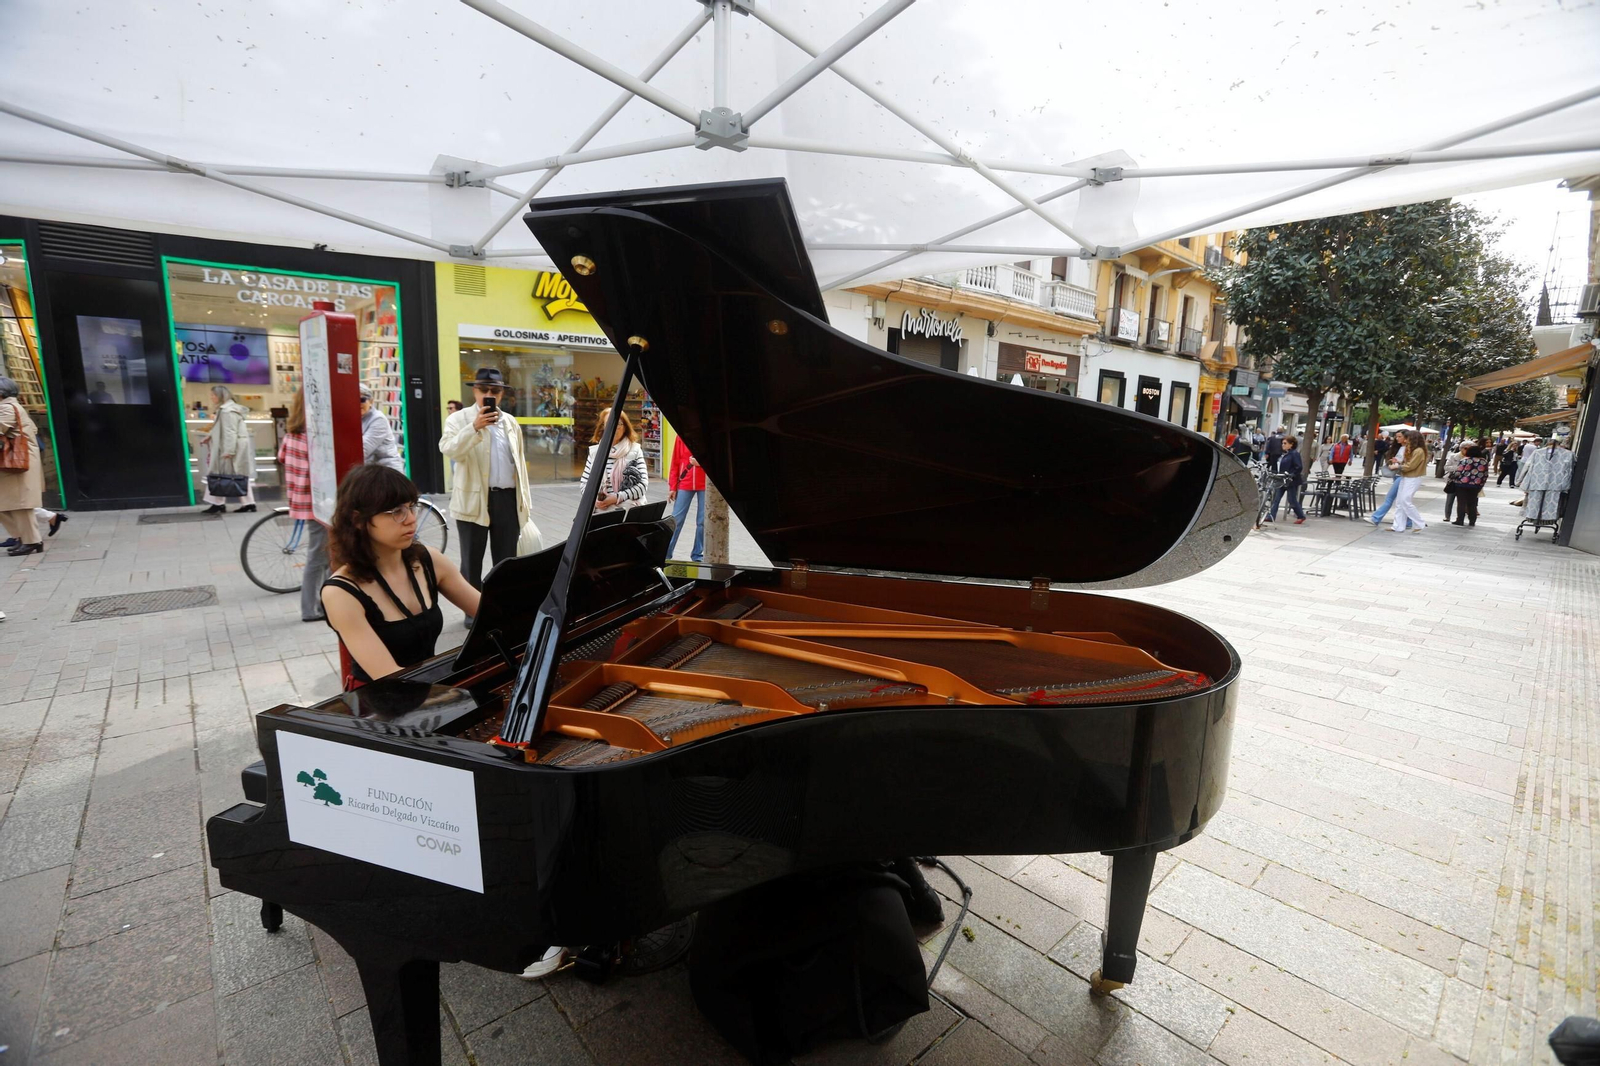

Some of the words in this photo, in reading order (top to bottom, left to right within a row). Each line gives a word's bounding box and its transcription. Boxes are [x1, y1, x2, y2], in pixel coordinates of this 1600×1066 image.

[201, 268, 236, 286] LA
[243, 273, 300, 292] CASA
[302, 279, 330, 295] DE
[335, 282, 372, 299] LAS
[237, 290, 346, 312] CARCASS
[494, 329, 550, 341] GOLOSINAS
[557, 334, 608, 345] APERITIVOS
[1142, 387, 1160, 396] BOSTON
[367, 787, 433, 812] FUNDACIÓN
[348, 797, 380, 813] Ricardo
[382, 805, 418, 822] Delgado
[420, 814, 460, 833] Vizcaíno
[416, 834, 462, 856] COVAP
